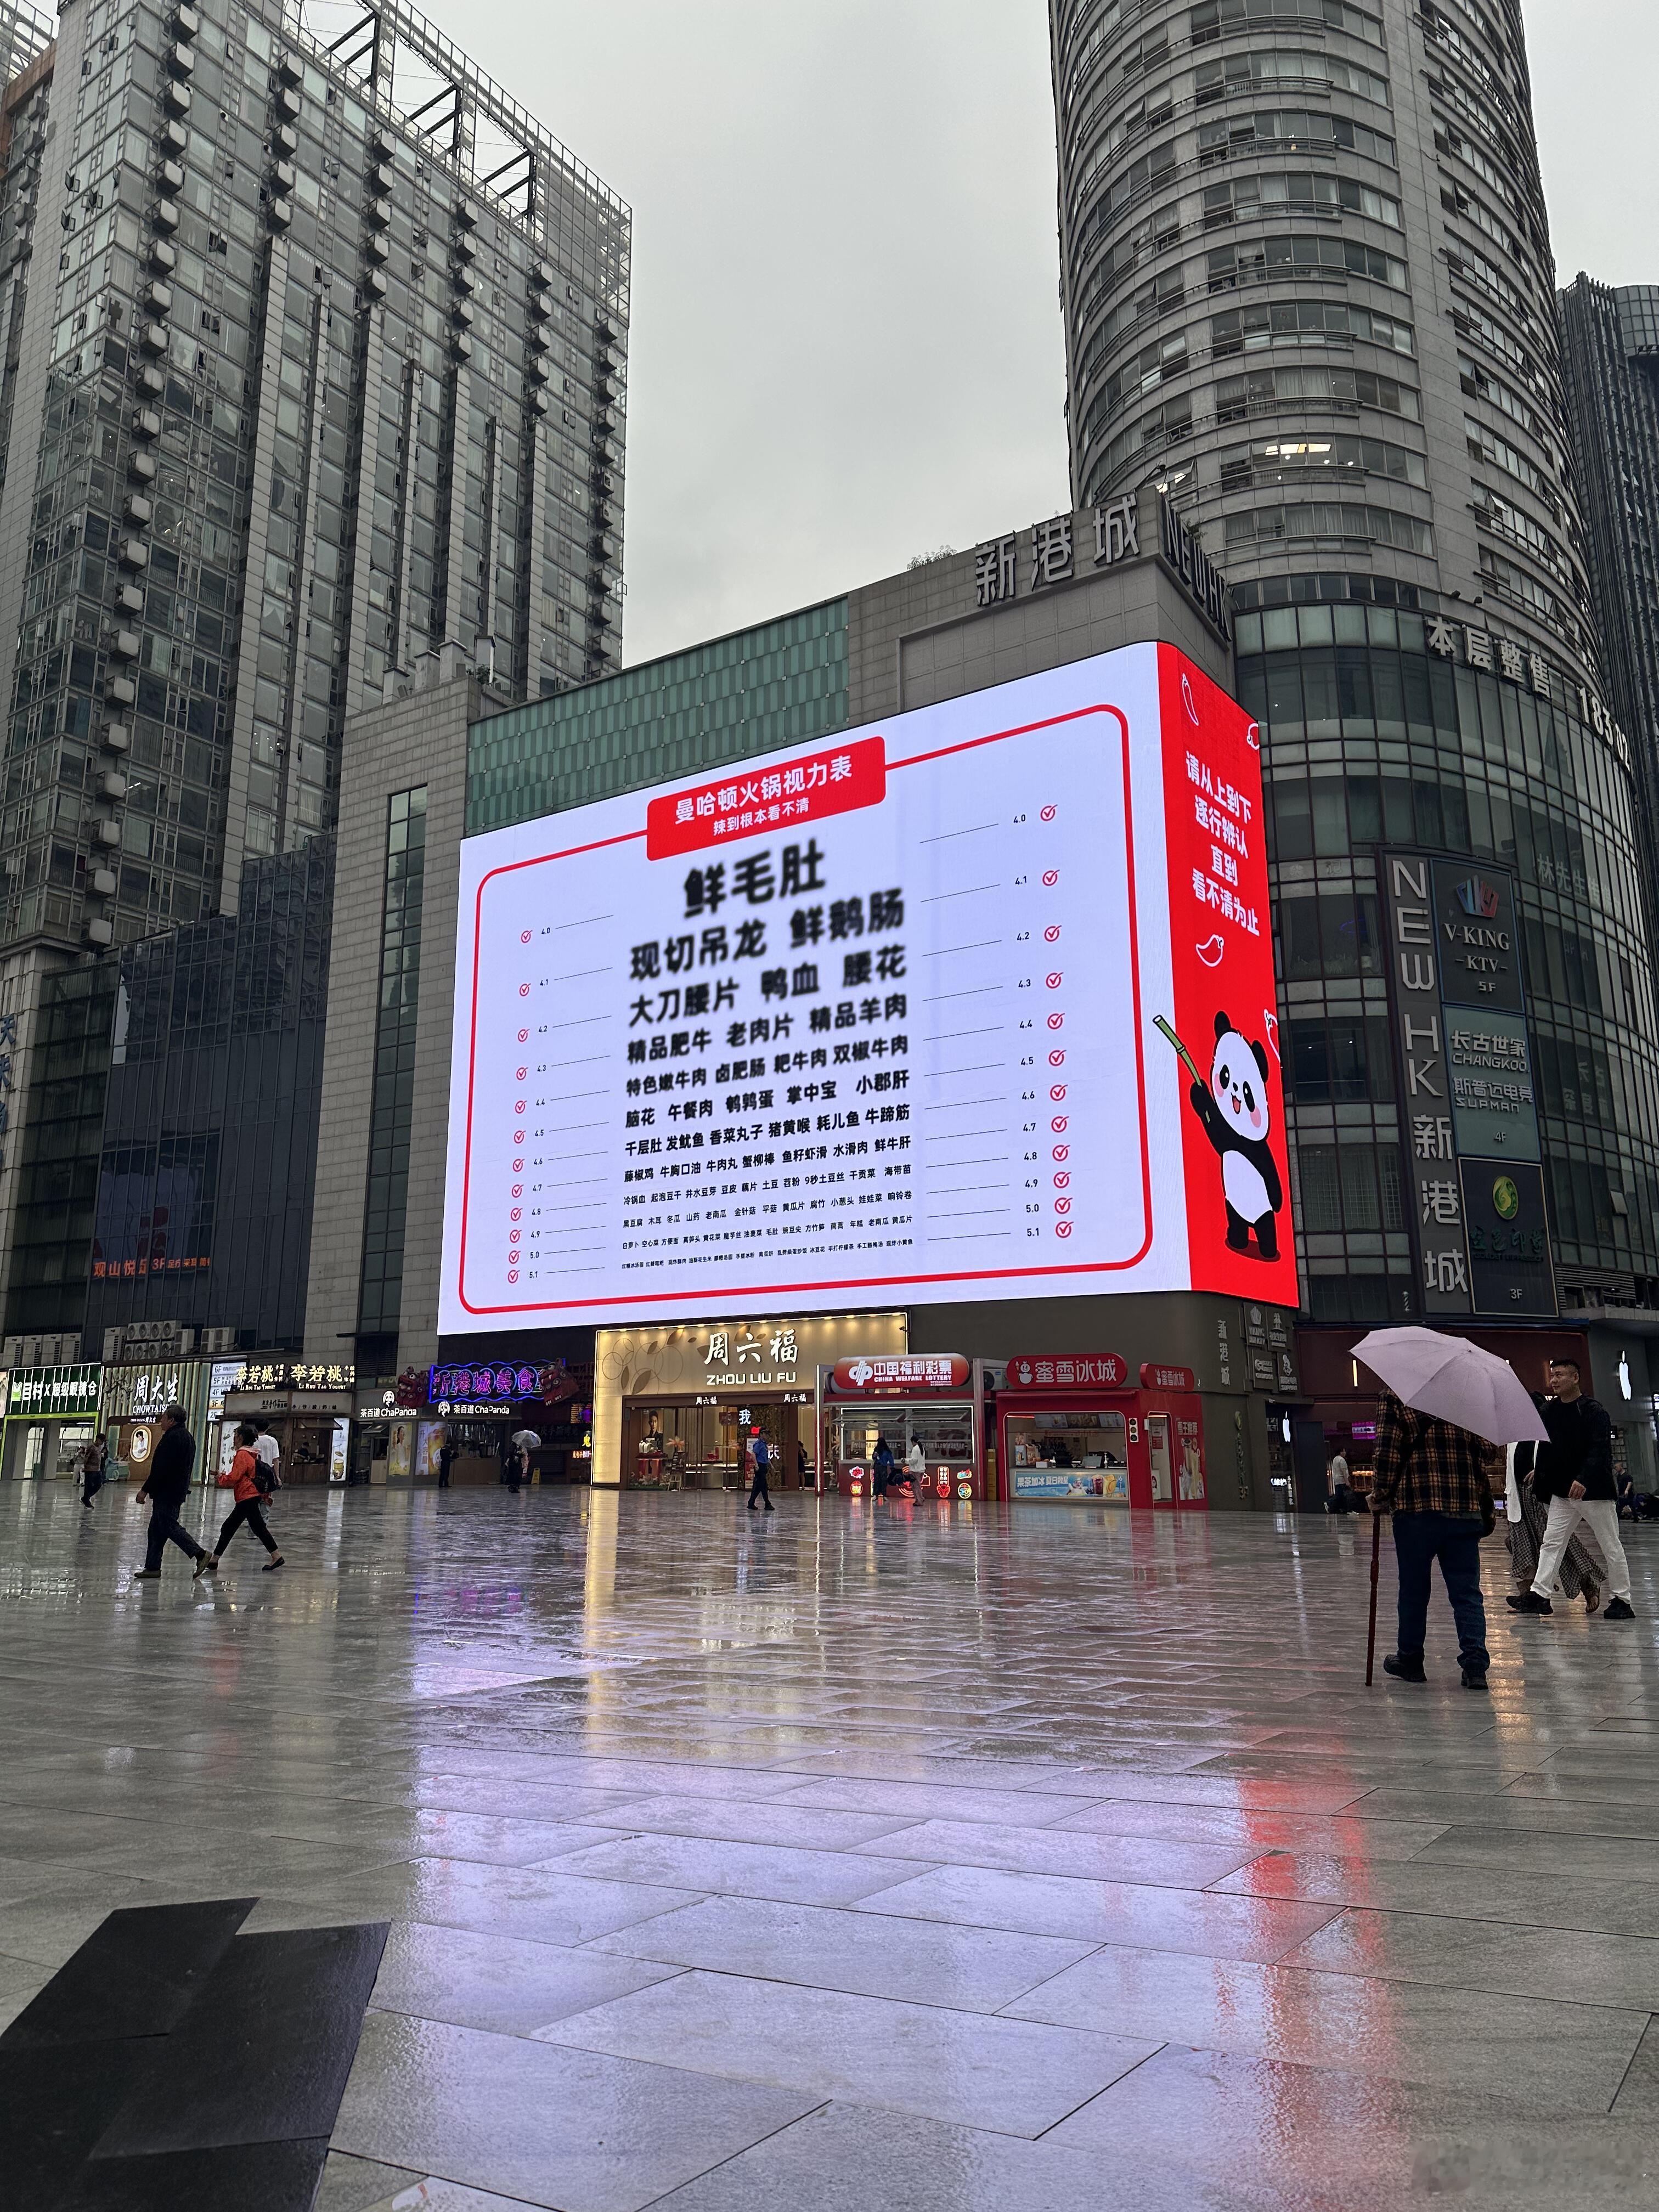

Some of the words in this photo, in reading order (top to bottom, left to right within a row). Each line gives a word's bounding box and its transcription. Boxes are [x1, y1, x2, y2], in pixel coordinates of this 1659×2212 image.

[975, 494, 1140, 606] 新港城
[1427, 617, 1551, 699] 本层整售
[675, 755, 852, 825] 曼哈顿火锅视力表
[1186, 750, 1252, 825] 请从上到下
[713, 798, 809, 836] 辣到根本看不清
[1013, 814, 1026, 823] 4.0
[1194, 794, 1249, 860] 逐行辨认
[1210, 844, 1238, 887] 直到
[682, 837, 826, 919] 鲜毛肚
[1015, 875, 1027, 885] 4.1
[1192, 867, 1260, 937] 看不清为止
[541, 927, 550, 935] 4.0
[1392, 860, 1435, 991] NEW
[629, 918, 767, 982] 现切吊龙
[788, 887, 905, 950] 鲜鹅肠
[1017, 932, 1030, 941] 4.2
[1443, 923, 1510, 951] V-KING
[540, 978, 549, 986] 4.1
[628, 976, 740, 1028] 大刀腰片
[760, 961, 820, 1003] 鸭血
[842, 943, 907, 988] 腰花
[1018, 979, 1031, 988] 4.3
[538, 1025, 548, 1033] 4.2
[627, 1026, 712, 1065] 精品肥牛
[725, 1012, 794, 1048] 老肉片
[808, 992, 907, 1034] 精品羊肉
[1019, 1019, 1033, 1029] 4.4
[1451, 1030, 1526, 1058] 长古世家
[1020, 1056, 1034, 1066] 4.5
[1404, 1014, 1444, 1097] HK
[537, 1064, 546, 1073] 4.3
[535, 1098, 545, 1106] 4.4
[667, 1098, 713, 1122] 午餐肉
[725, 1088, 774, 1114] 鹌鹑蛋
[786, 1079, 837, 1105] 掌中宝
[855, 1068, 910, 1095] 小郡肝
[1022, 1091, 1035, 1101] 4.6
[1455, 1097, 1520, 1114] SUPMAN
[624, 1136, 662, 1156] 千层肚
[709, 1123, 763, 1146] 香菜丸子
[768, 1116, 811, 1138] 猪黄喉
[815, 1110, 860, 1132] 耗儿鱼
[864, 1103, 910, 1125] 牛蹄筋
[1023, 1122, 1036, 1132] 4.7
[1494, 1131, 1507, 1142] 4F
[623, 1166, 654, 1183] 藤椒鸡
[659, 1161, 701, 1178] 牛胸口油
[706, 1156, 738, 1172] 牛肉丸
[742, 1152, 775, 1169] 蟹柳棒
[781, 1145, 827, 1163] 鱼籽虾滑
[832, 1140, 868, 1158] 水滑肉
[873, 1135, 911, 1152] 鲜牛肝
[1024, 1152, 1037, 1161] 4.8
[623, 1194, 646, 1205] 冷锅血
[650, 1189, 681, 1203] 起泡豆干
[685, 1186, 717, 1199] 井水豆芽
[720, 1183, 737, 1195] 豆皮
[741, 1181, 758, 1193] 藕片
[761, 1178, 779, 1190] 土豆
[804, 1171, 845, 1185] 9秒土豆丝
[848, 1167, 876, 1181] 干贡菜
[883, 1163, 912, 1177] 海带苗
[1025, 1178, 1038, 1188] 4.9
[647, 1216, 662, 1226] 木耳
[666, 1214, 681, 1223] 冬瓜
[685, 1211, 700, 1222] 山药
[704, 1209, 727, 1220] 老南瓜
[733, 1205, 756, 1217] 金针菇
[761, 1203, 777, 1214] 平菇
[782, 1200, 805, 1212] 黄瓜片
[809, 1198, 826, 1209] 腐竹
[830, 1195, 854, 1207] 小葱头
[858, 1192, 883, 1204] 娃娃菜
[887, 1189, 912, 1201] 响铃卷
[1026, 1203, 1039, 1213] 5.0
[1413, 1114, 1469, 1293] 新港城
[1026, 1227, 1039, 1237] 5.1
[530, 1251, 539, 1259] 5.0
[529, 1271, 538, 1279] 5.1
[1510, 1288, 1523, 1300] 3F
[704, 1329, 799, 1365] 周六福
[236, 1364, 274, 1385] 李若桃
[290, 1363, 343, 1382] 李若桃
[873, 1360, 952, 1375] 中国福利彩票
[1035, 1359, 1117, 1383] 蜜雪冰城
[433, 1367, 544, 1395] 新港城美食
[707, 1374, 746, 1385] ZHOU
[750, 1373, 772, 1384] LIU
[777, 1372, 797, 1383] FU
[1161, 1370, 1186, 1387] 蜜雪冰城
[134, 1373, 178, 1402] 周大生
[696, 1396, 718, 1405] 周六福
[783, 1393, 807, 1403] 周六福
[360, 1408, 380, 1418] 茶百道
[381, 1406, 417, 1417] ChaPanda
[453, 1404, 474, 1414] 茶百道
[475, 1404, 510, 1414] ChaPanda
[739, 1409, 751, 1425] 我
